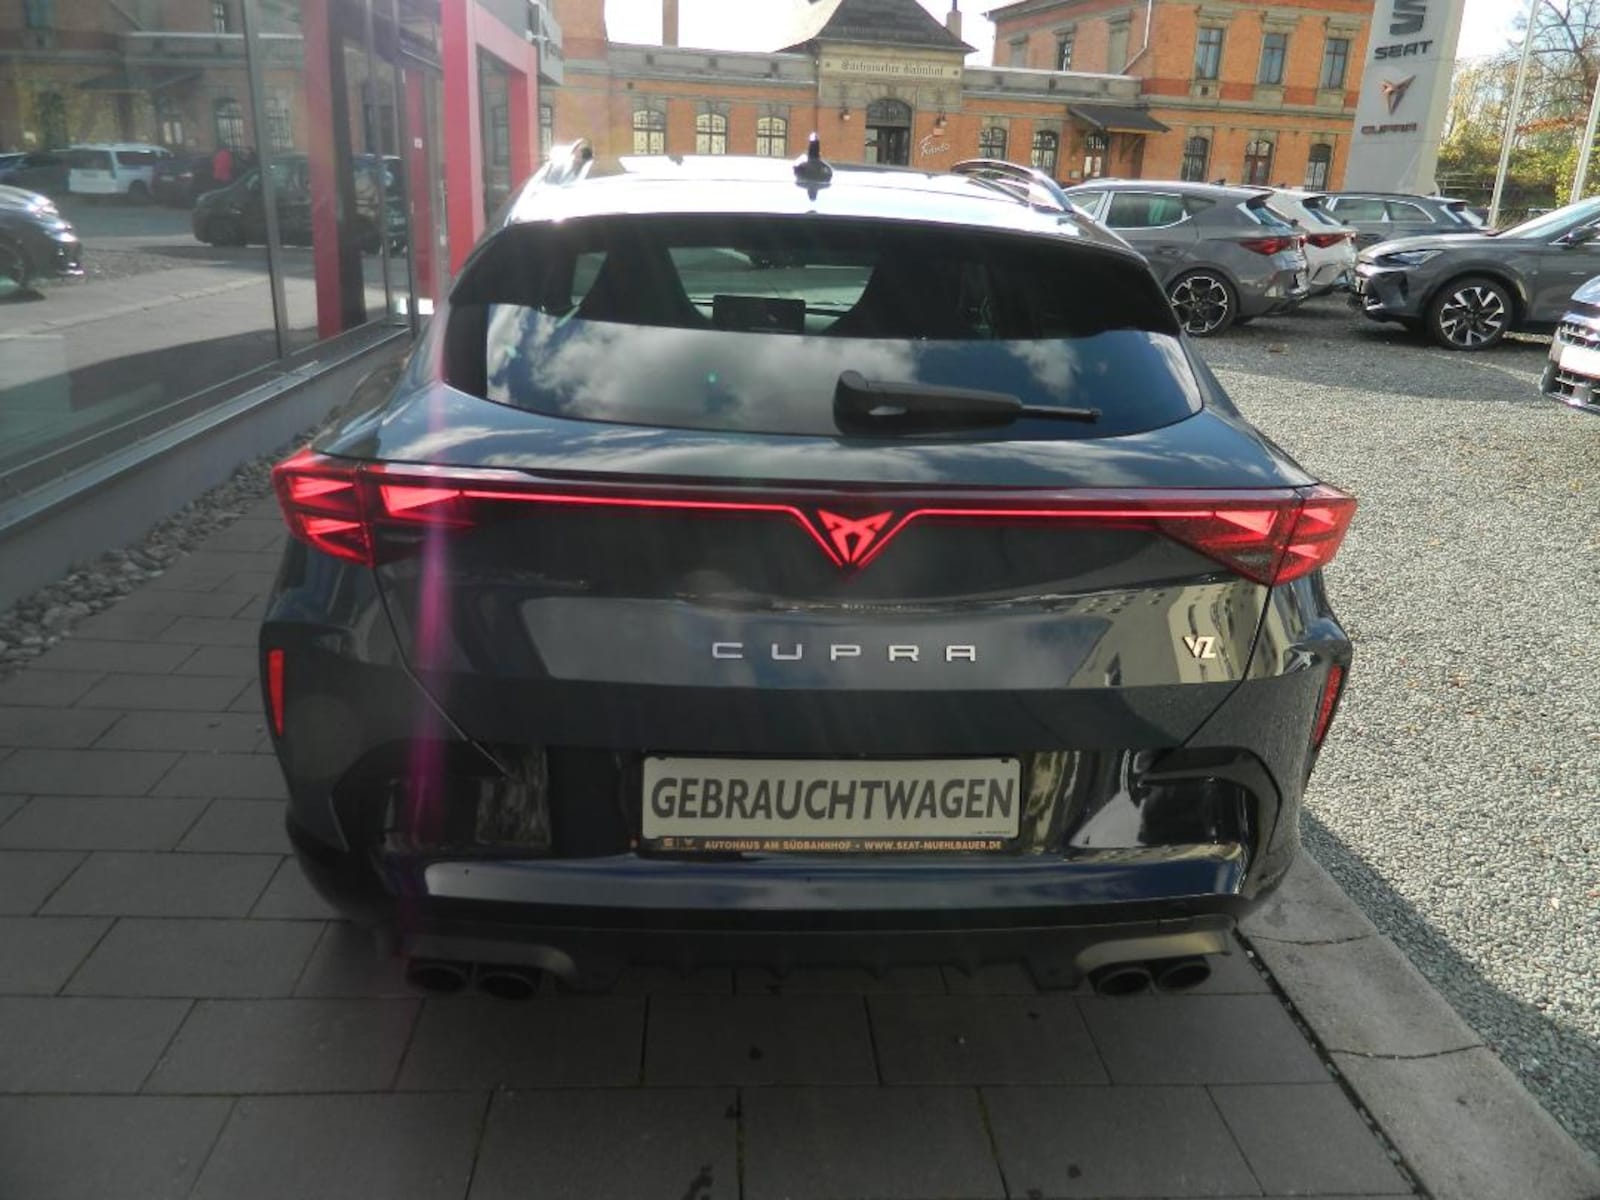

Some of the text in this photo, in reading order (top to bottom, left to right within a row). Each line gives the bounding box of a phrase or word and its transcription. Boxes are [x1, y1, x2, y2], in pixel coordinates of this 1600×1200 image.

[1374, 40, 1433, 60] SEAT
[1361, 122, 1417, 136] CUPRA
[711, 641, 977, 662] CUPRA
[1183, 635, 1217, 660] VZ
[651, 777, 1015, 820] GEBRAUCHTWAGEN
[704, 840, 760, 850] AUTOHAUS
[764, 840, 779, 850] AM
[783, 839, 852, 850] SÜDBAHNHOF
